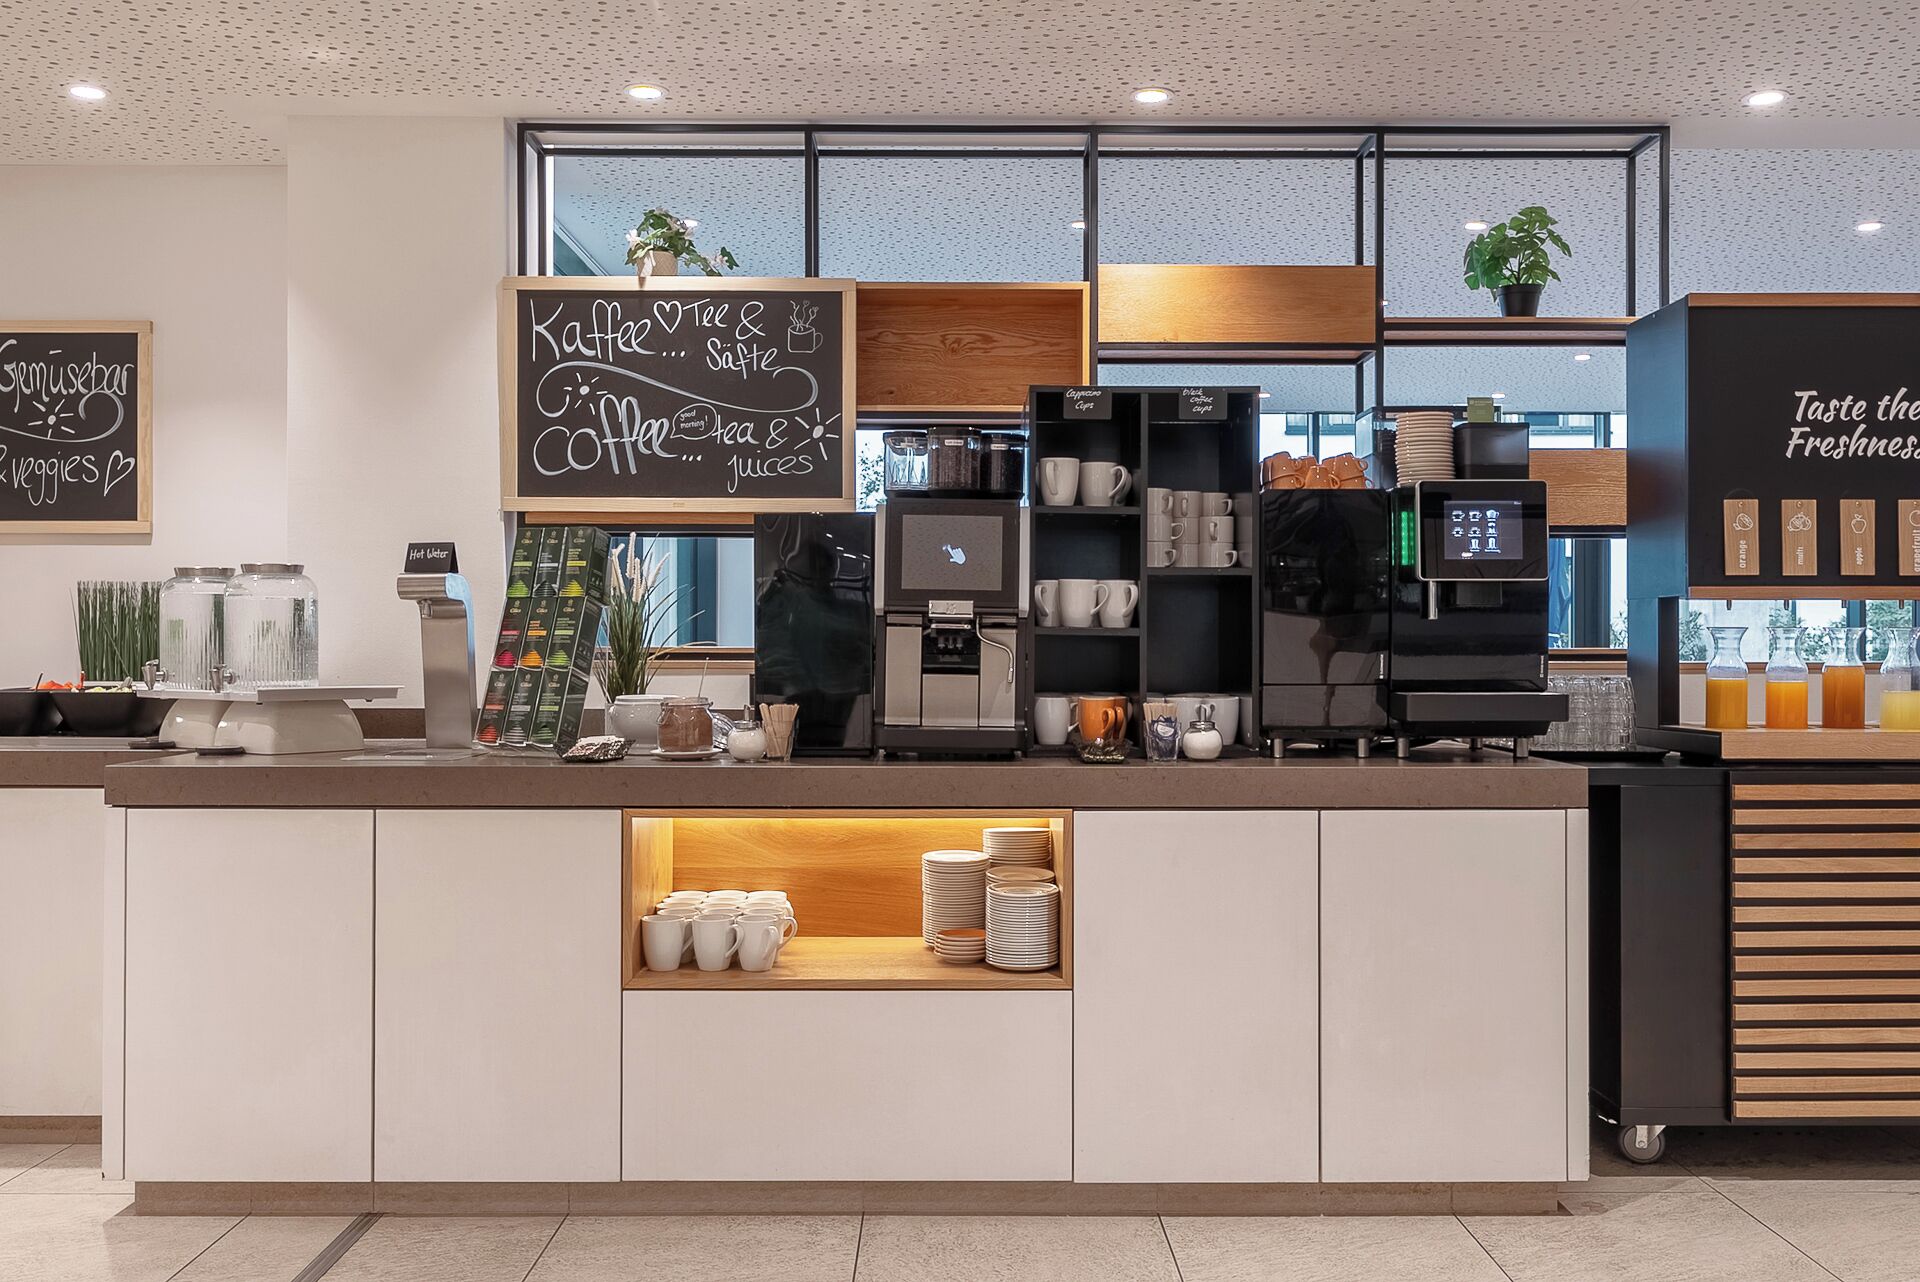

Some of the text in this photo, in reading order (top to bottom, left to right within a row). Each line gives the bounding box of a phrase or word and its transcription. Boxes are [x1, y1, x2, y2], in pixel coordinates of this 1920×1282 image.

[683, 298, 767, 340] Tee &
[706, 337, 782, 380] Säfte
[680, 410, 696, 421] good
[1794, 387, 1920, 423] Taste the
[713, 414, 788, 449] tea &
[12, 451, 99, 506] veggies
[409, 549, 425, 560] Hot
[1739, 540, 1748, 568] orange
[1855, 547, 1864, 566] apple
